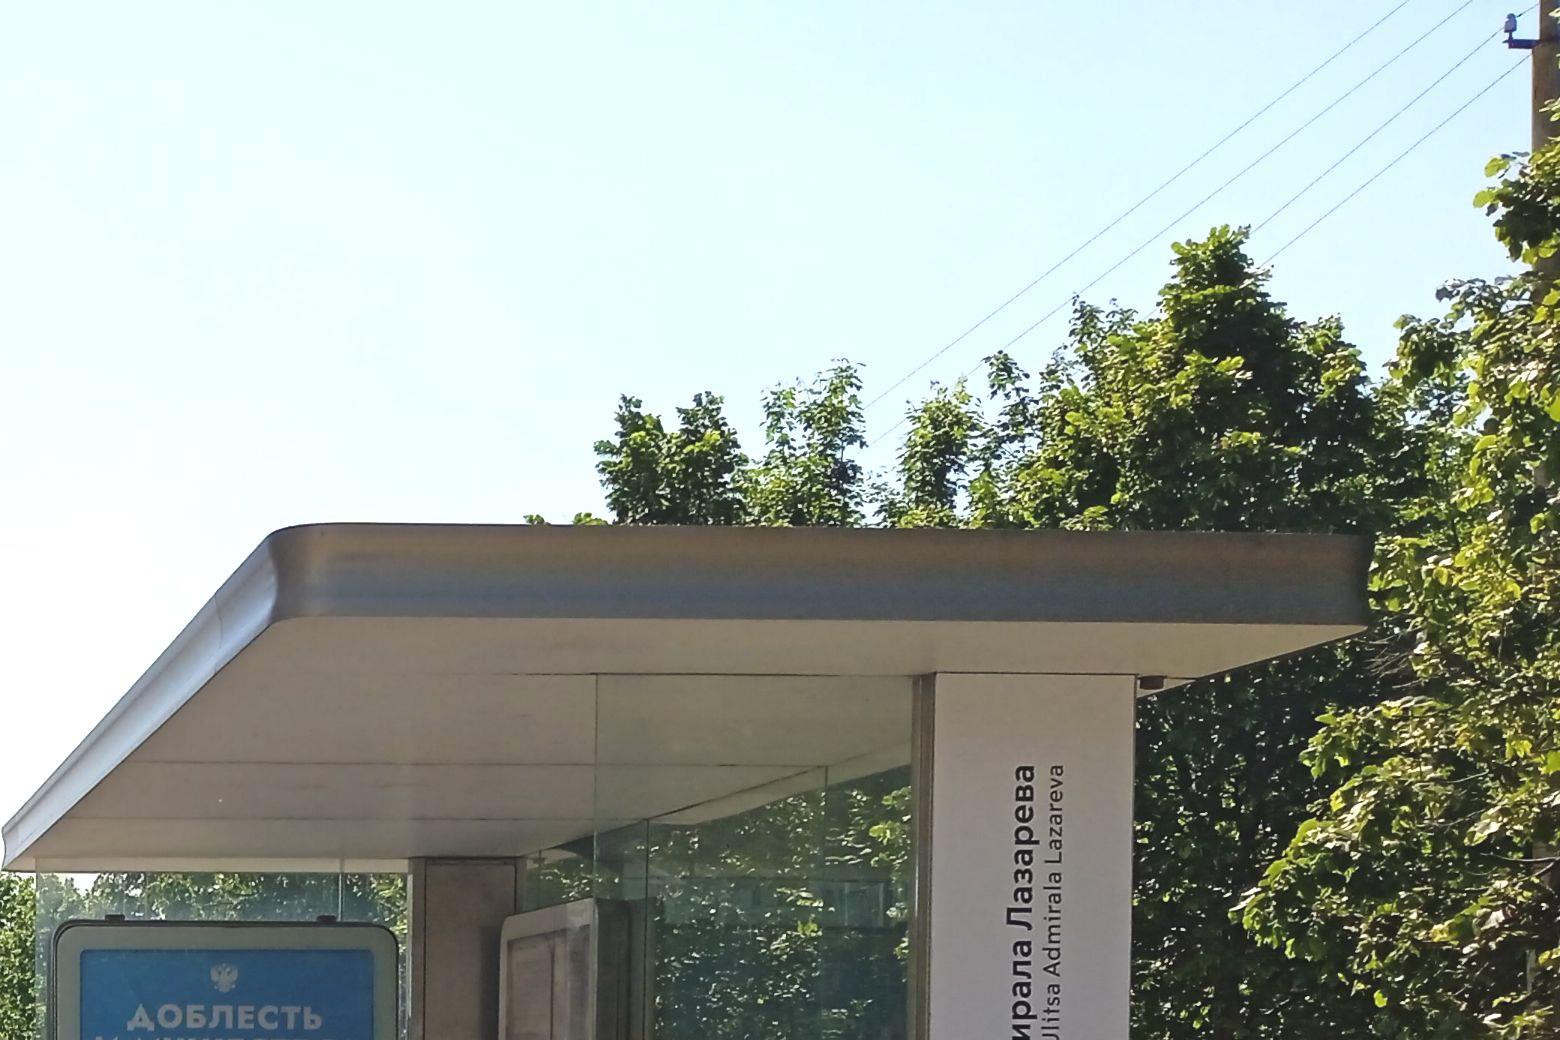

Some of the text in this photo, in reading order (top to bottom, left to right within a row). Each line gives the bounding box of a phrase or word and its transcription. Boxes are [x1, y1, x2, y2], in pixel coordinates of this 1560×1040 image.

[1005, 764, 1041, 931] Лазарева
[1043, 764, 1064, 863] Lazareva
[1042, 872, 1062, 978] Admirala
[126, 1003, 323, 1032] ДОБЛЕСТЬ
